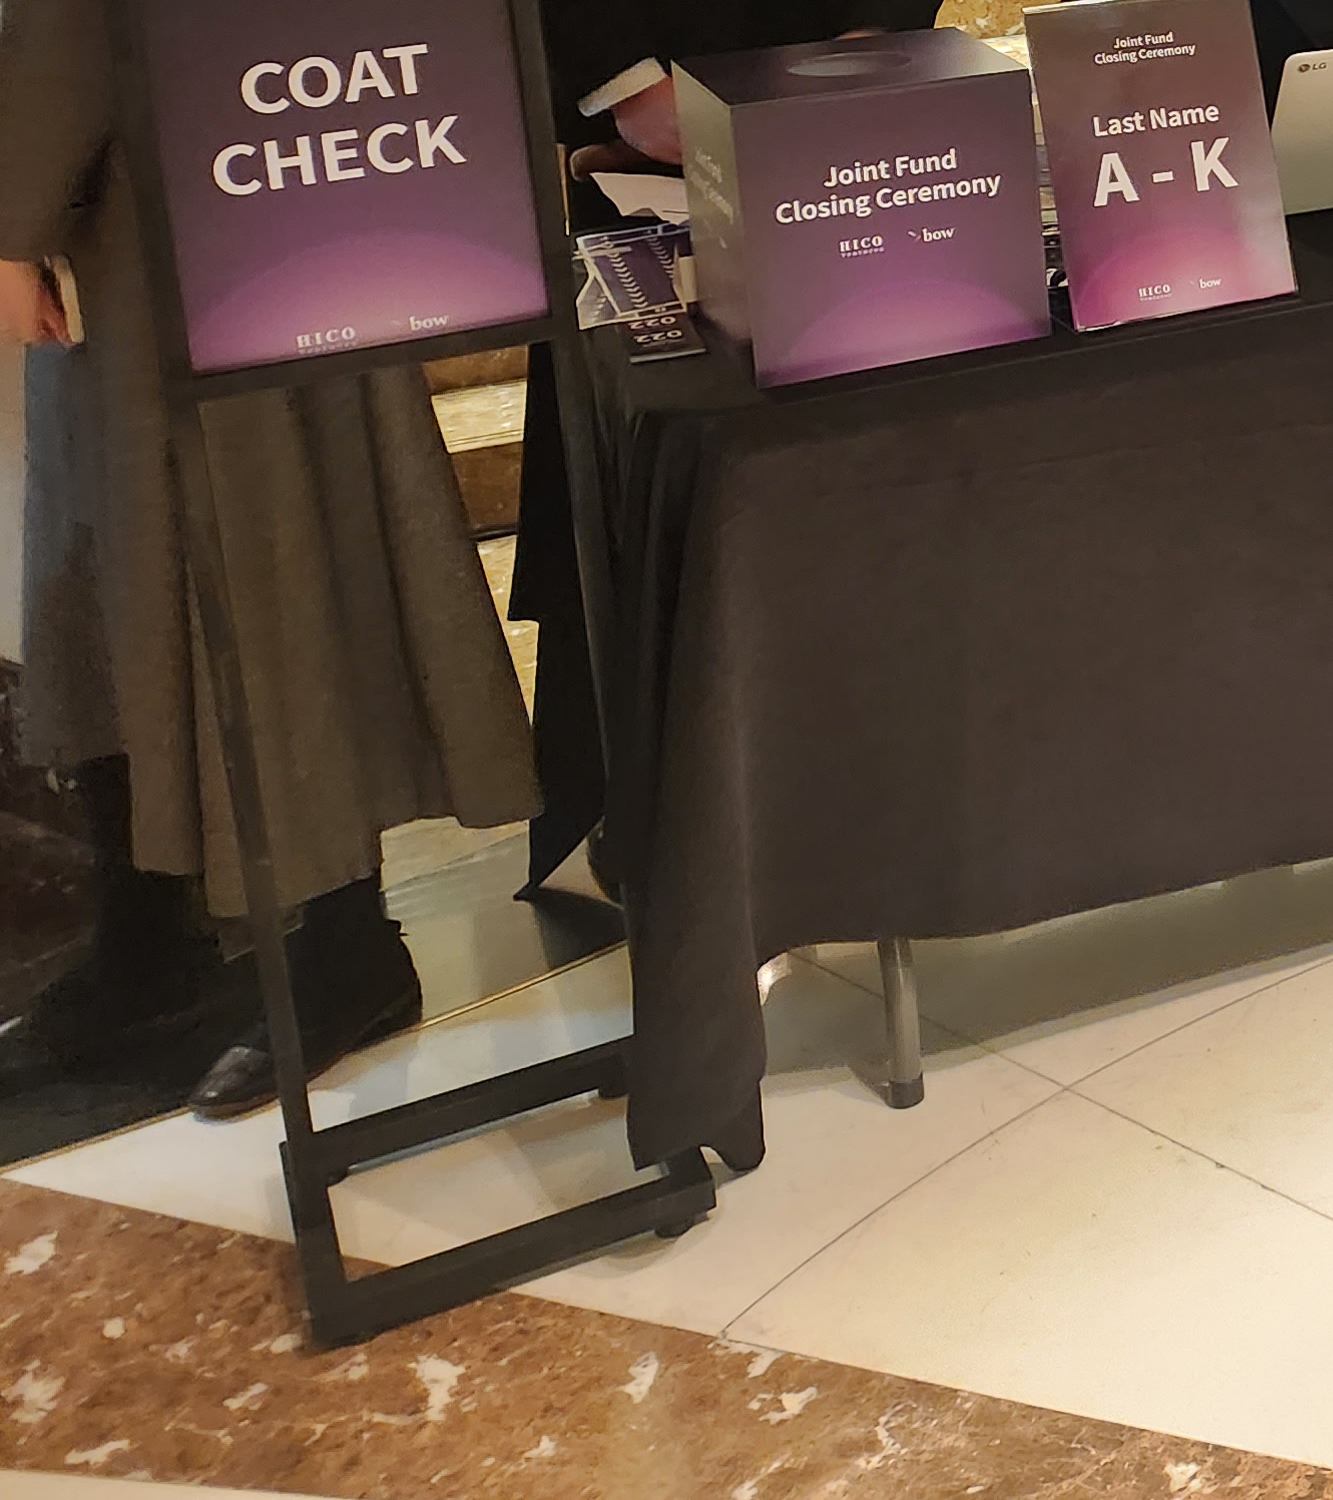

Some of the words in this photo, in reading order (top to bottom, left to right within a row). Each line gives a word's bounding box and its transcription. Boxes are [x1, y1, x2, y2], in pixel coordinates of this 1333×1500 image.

[1113, 34, 1144, 49] Joint
[1145, 31, 1174, 46] Fund
[1094, 50, 1138, 65] Closing
[1138, 44, 1196, 61] Ceremony
[1312, 61, 1327, 71] LG
[240, 43, 429, 115] COAT
[1093, 111, 1146, 137] Last
[1149, 104, 1220, 130] Name
[212, 114, 468, 196] CHECK
[823, 160, 891, 188] Joint
[895, 147, 958, 177] Fund
[1093, 152, 1140, 207] A
[1152, 170, 1174, 184] -
[1190, 136, 1239, 192] K
[775, 194, 873, 224] Closing
[875, 174, 1002, 209] Ceremony
[921, 226, 956, 243] bow
[1198, 278, 1222, 290] bow
[408, 314, 450, 332] bow
[633, 329, 683, 344] 022
